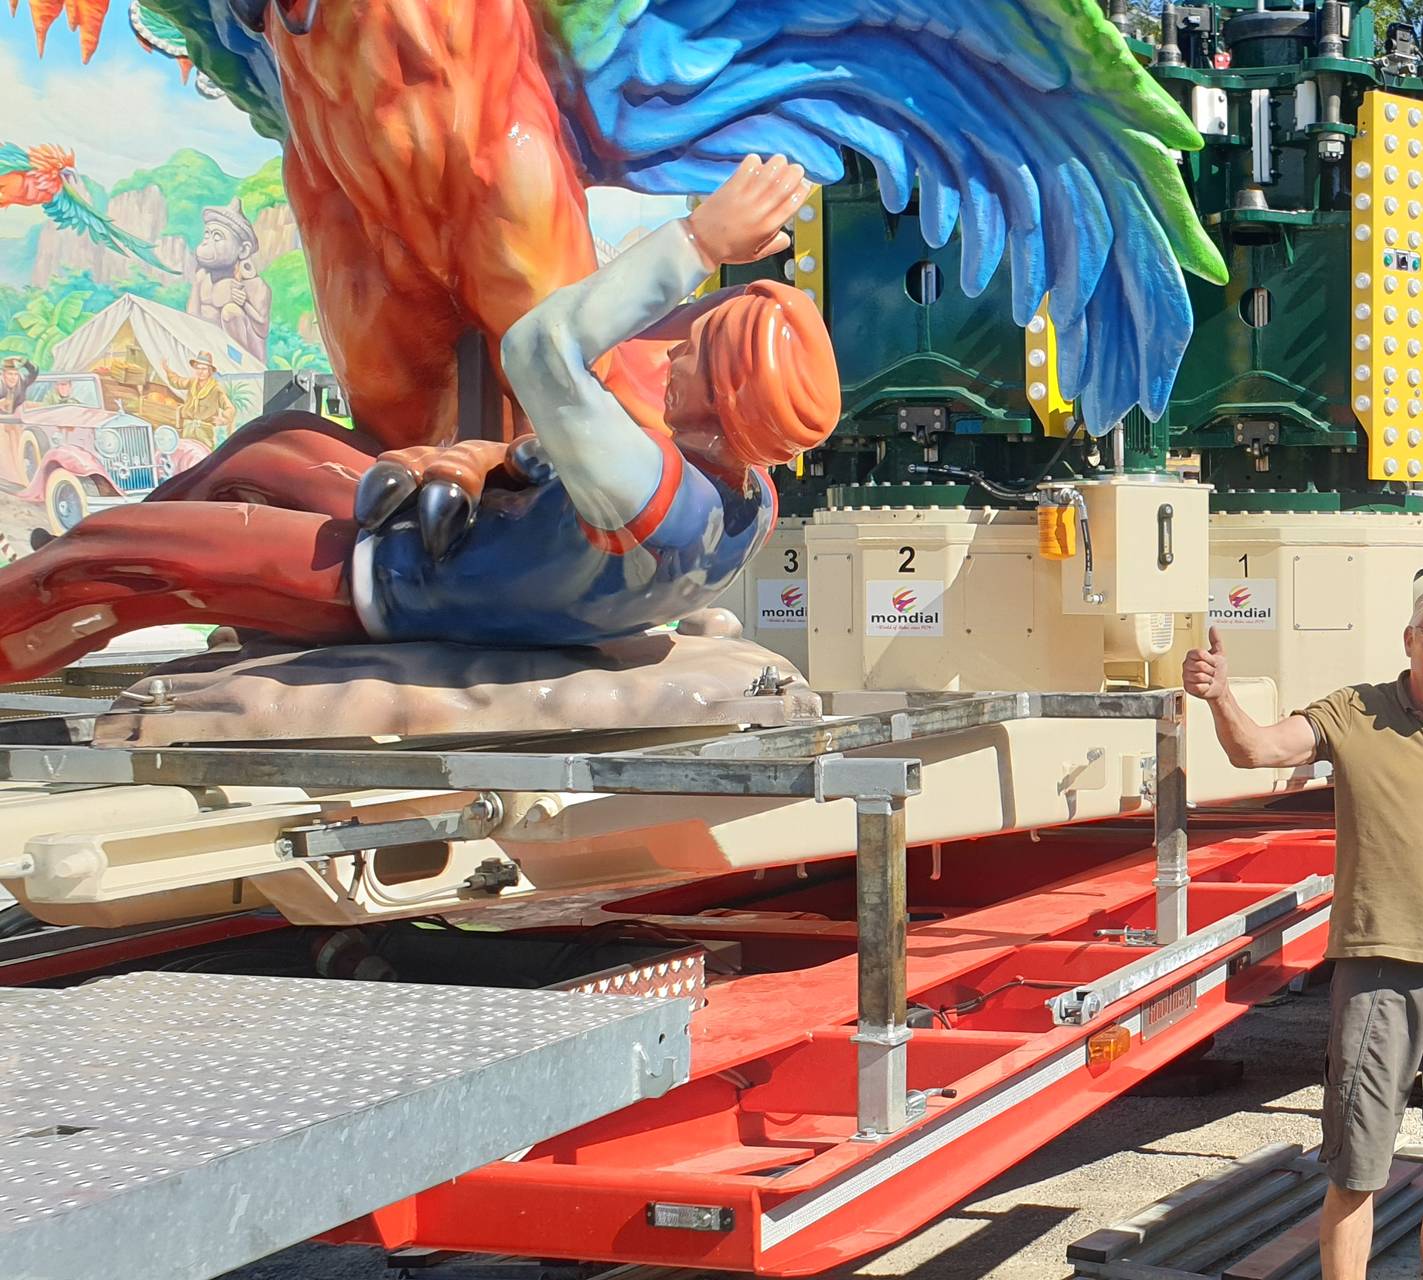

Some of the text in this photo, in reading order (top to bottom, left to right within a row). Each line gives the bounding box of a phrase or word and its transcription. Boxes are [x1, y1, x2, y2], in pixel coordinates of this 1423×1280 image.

[784, 549, 798, 573] 3
[898, 546, 916, 573] 2
[1238, 553, 1249, 578] 1
[871, 612, 939, 624] mondial
[1209, 608, 1271, 618] mondial
